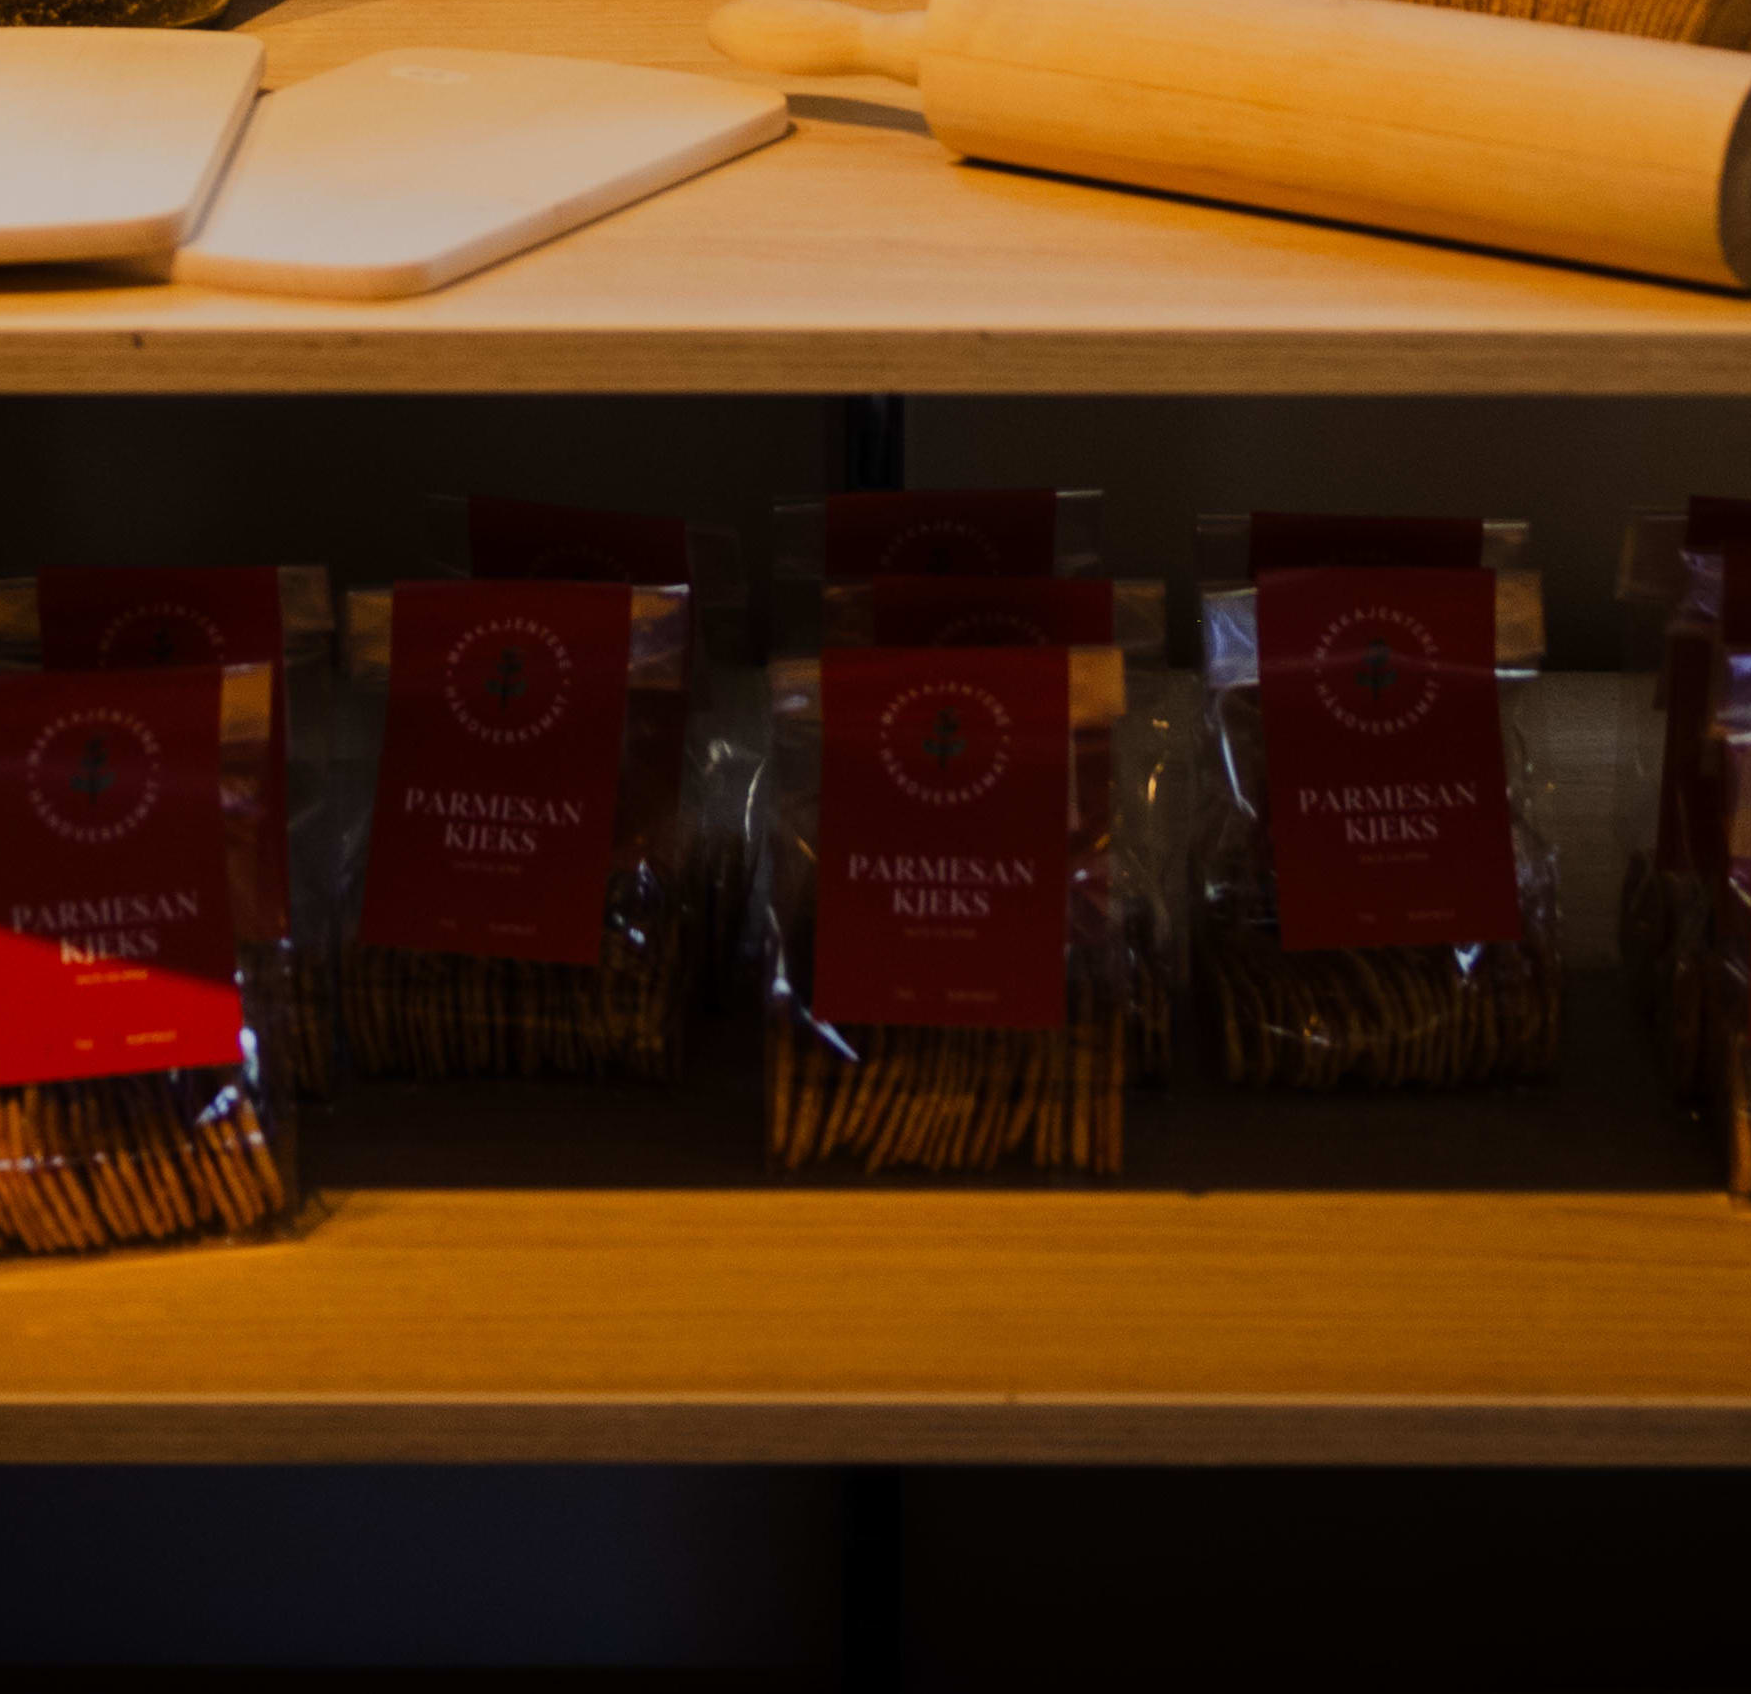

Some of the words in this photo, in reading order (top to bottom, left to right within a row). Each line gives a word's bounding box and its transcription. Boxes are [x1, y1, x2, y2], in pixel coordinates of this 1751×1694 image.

[403, 786, 583, 827] PARMESAN
[1298, 779, 1478, 816] PARMESAN
[443, 821, 537, 856] KJEKS
[1342, 815, 1440, 847] KJEKS
[847, 851, 1037, 888] PARMESAN
[10, 890, 200, 936] PARMESAN
[891, 887, 991, 920] KJEKS
[59, 926, 161, 966] KJEKS
